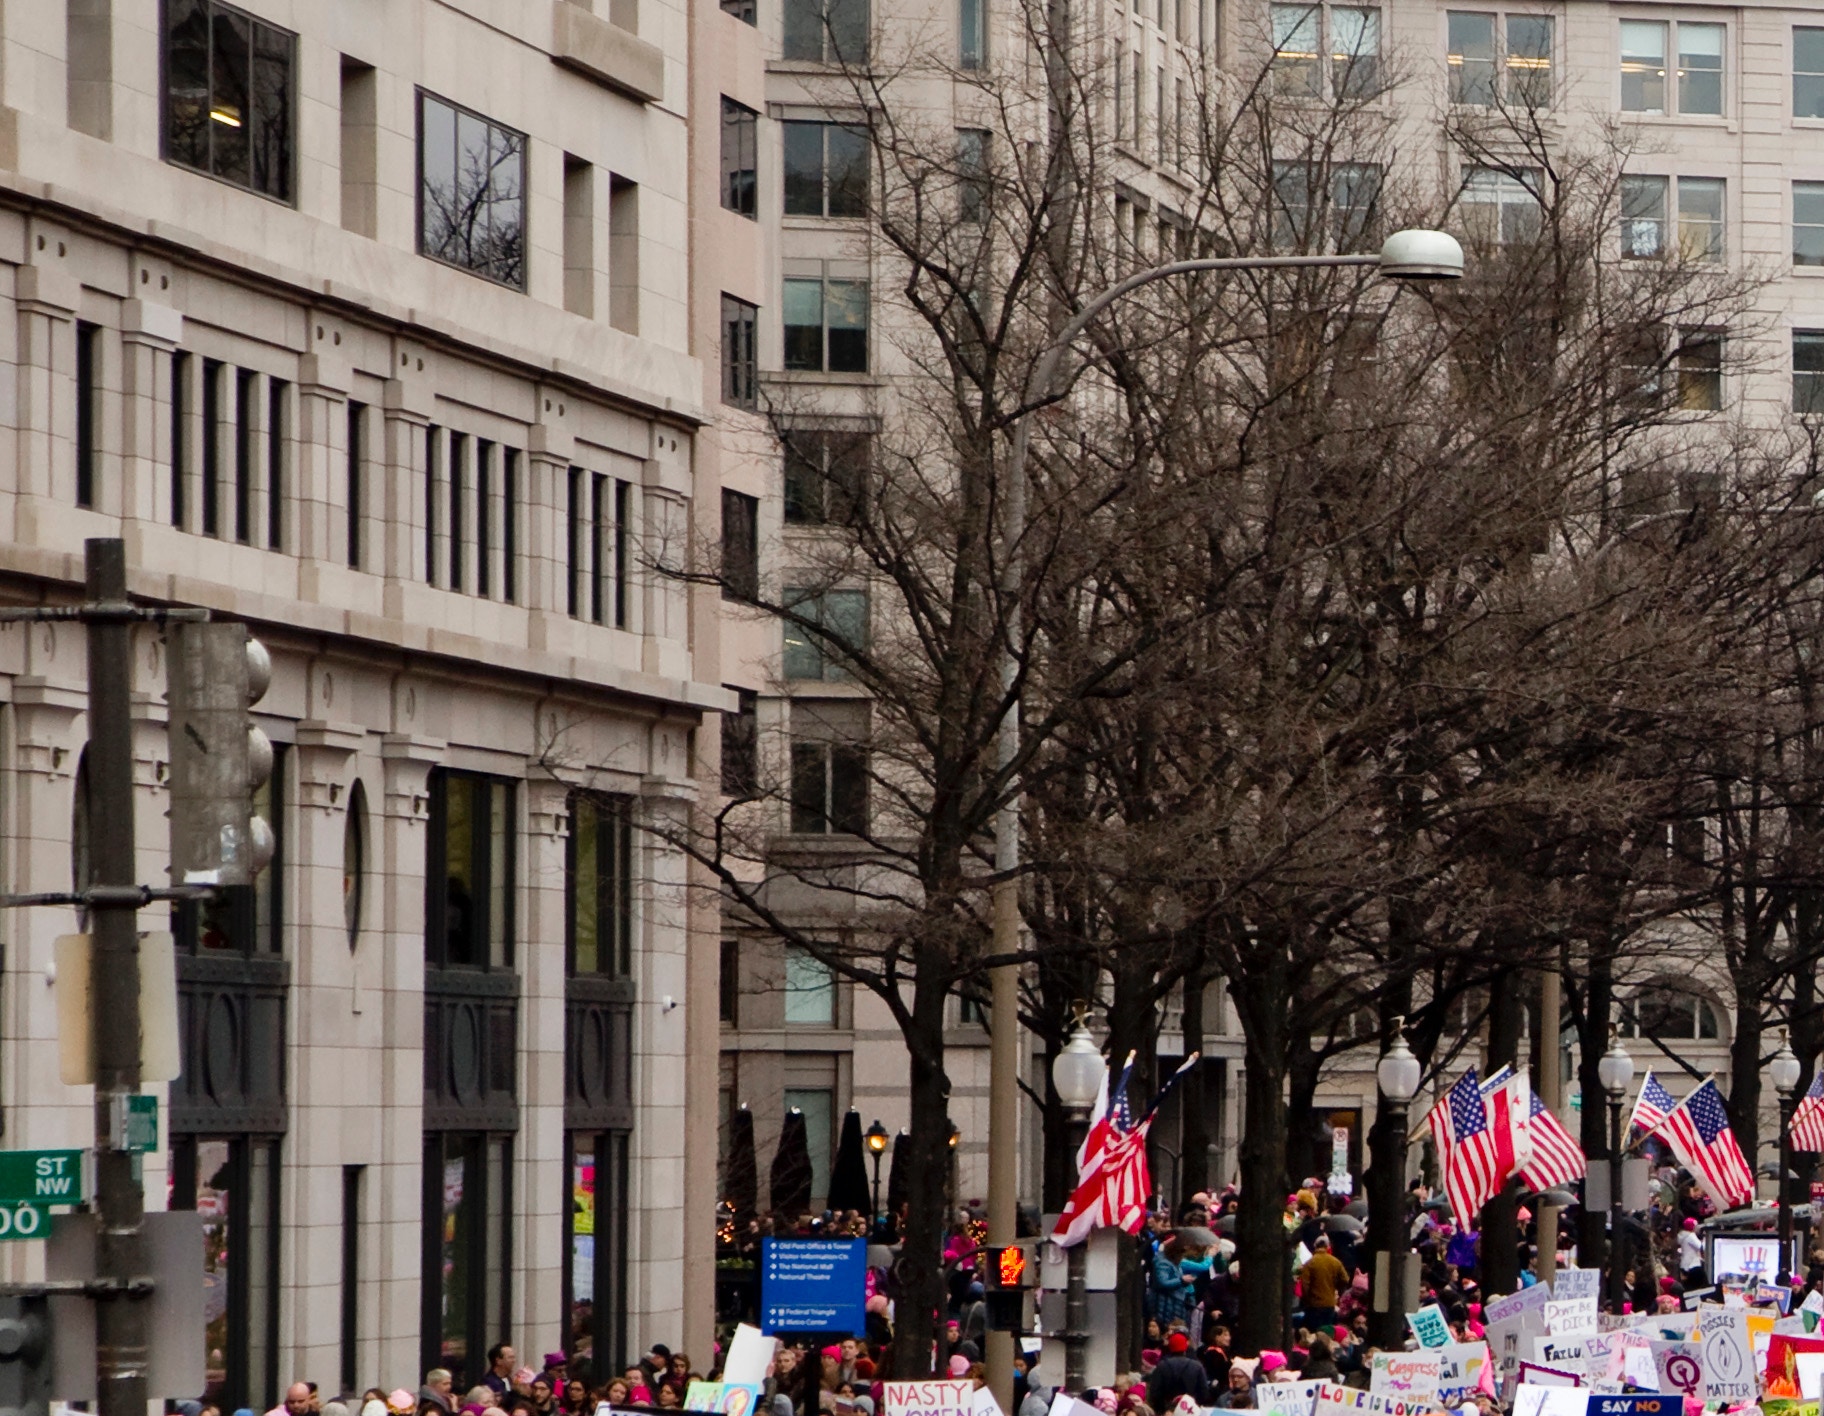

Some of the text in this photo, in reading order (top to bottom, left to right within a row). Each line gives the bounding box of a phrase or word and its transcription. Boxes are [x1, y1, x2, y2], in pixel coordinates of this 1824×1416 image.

[35, 1158, 66, 1175] ST
[36, 1177, 73, 1194] NW
[888, 1384, 969, 1405] NASTY
